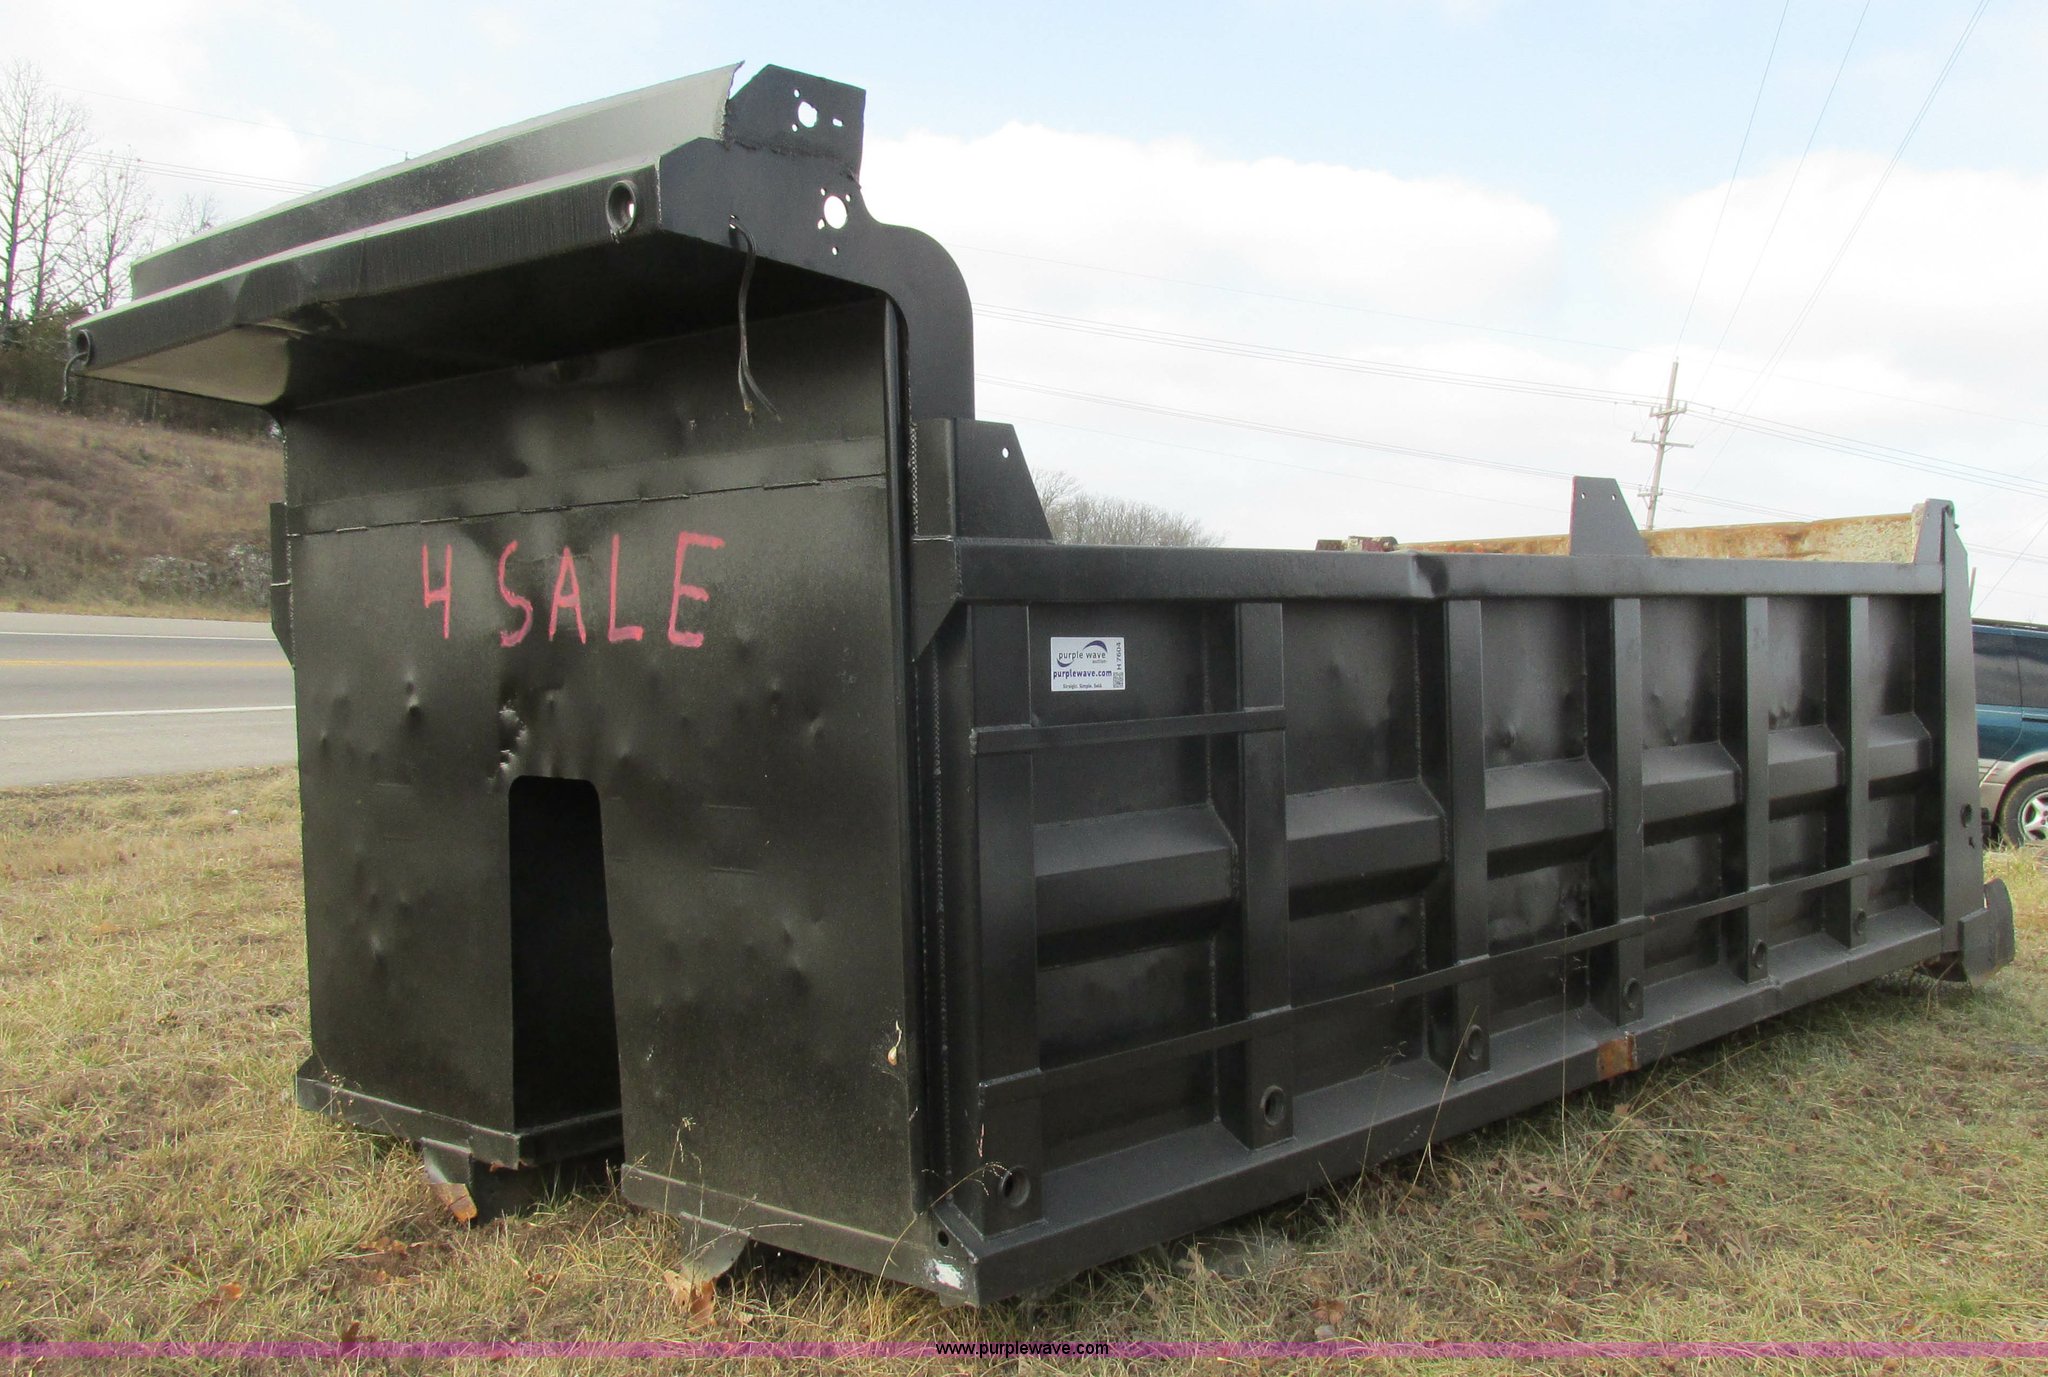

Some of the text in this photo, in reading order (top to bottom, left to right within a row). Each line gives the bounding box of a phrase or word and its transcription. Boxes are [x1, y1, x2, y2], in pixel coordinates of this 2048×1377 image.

[421, 531, 726, 648] 4 SALE
[1058, 651, 1084, 660] purple
[1053, 669, 1112, 679] purplewave.com
